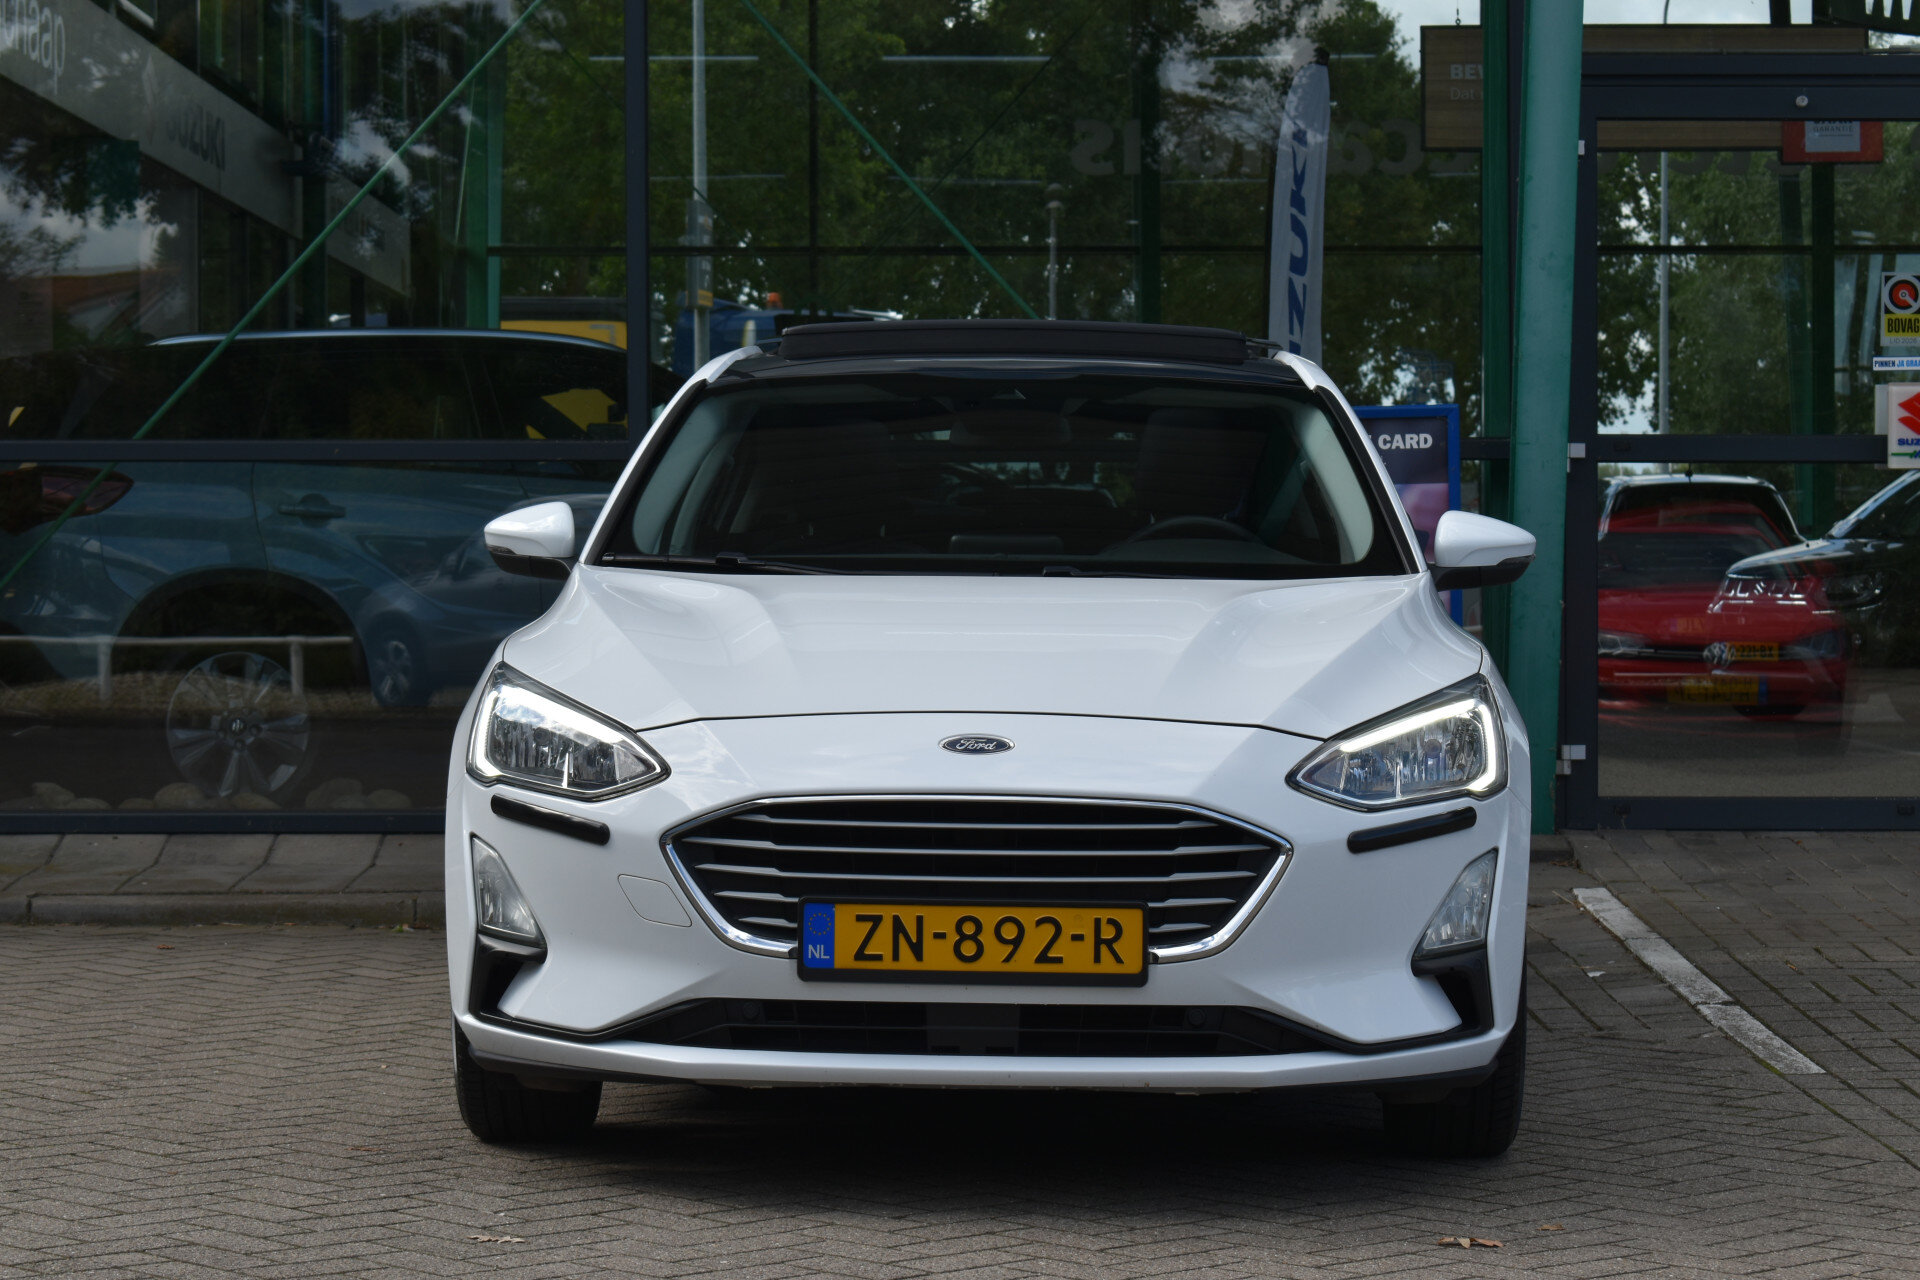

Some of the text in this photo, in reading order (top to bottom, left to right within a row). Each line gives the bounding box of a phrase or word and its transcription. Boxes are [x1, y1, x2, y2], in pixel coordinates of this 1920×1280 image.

[1288, 121, 1309, 355] ZUKI
[1887, 317, 1920, 334] BOVAG
[1378, 433, 1433, 450] CARD
[956, 738, 997, 750] Ford
[853, 913, 1125, 965] ZN-892-R
[808, 944, 830, 959] NL
